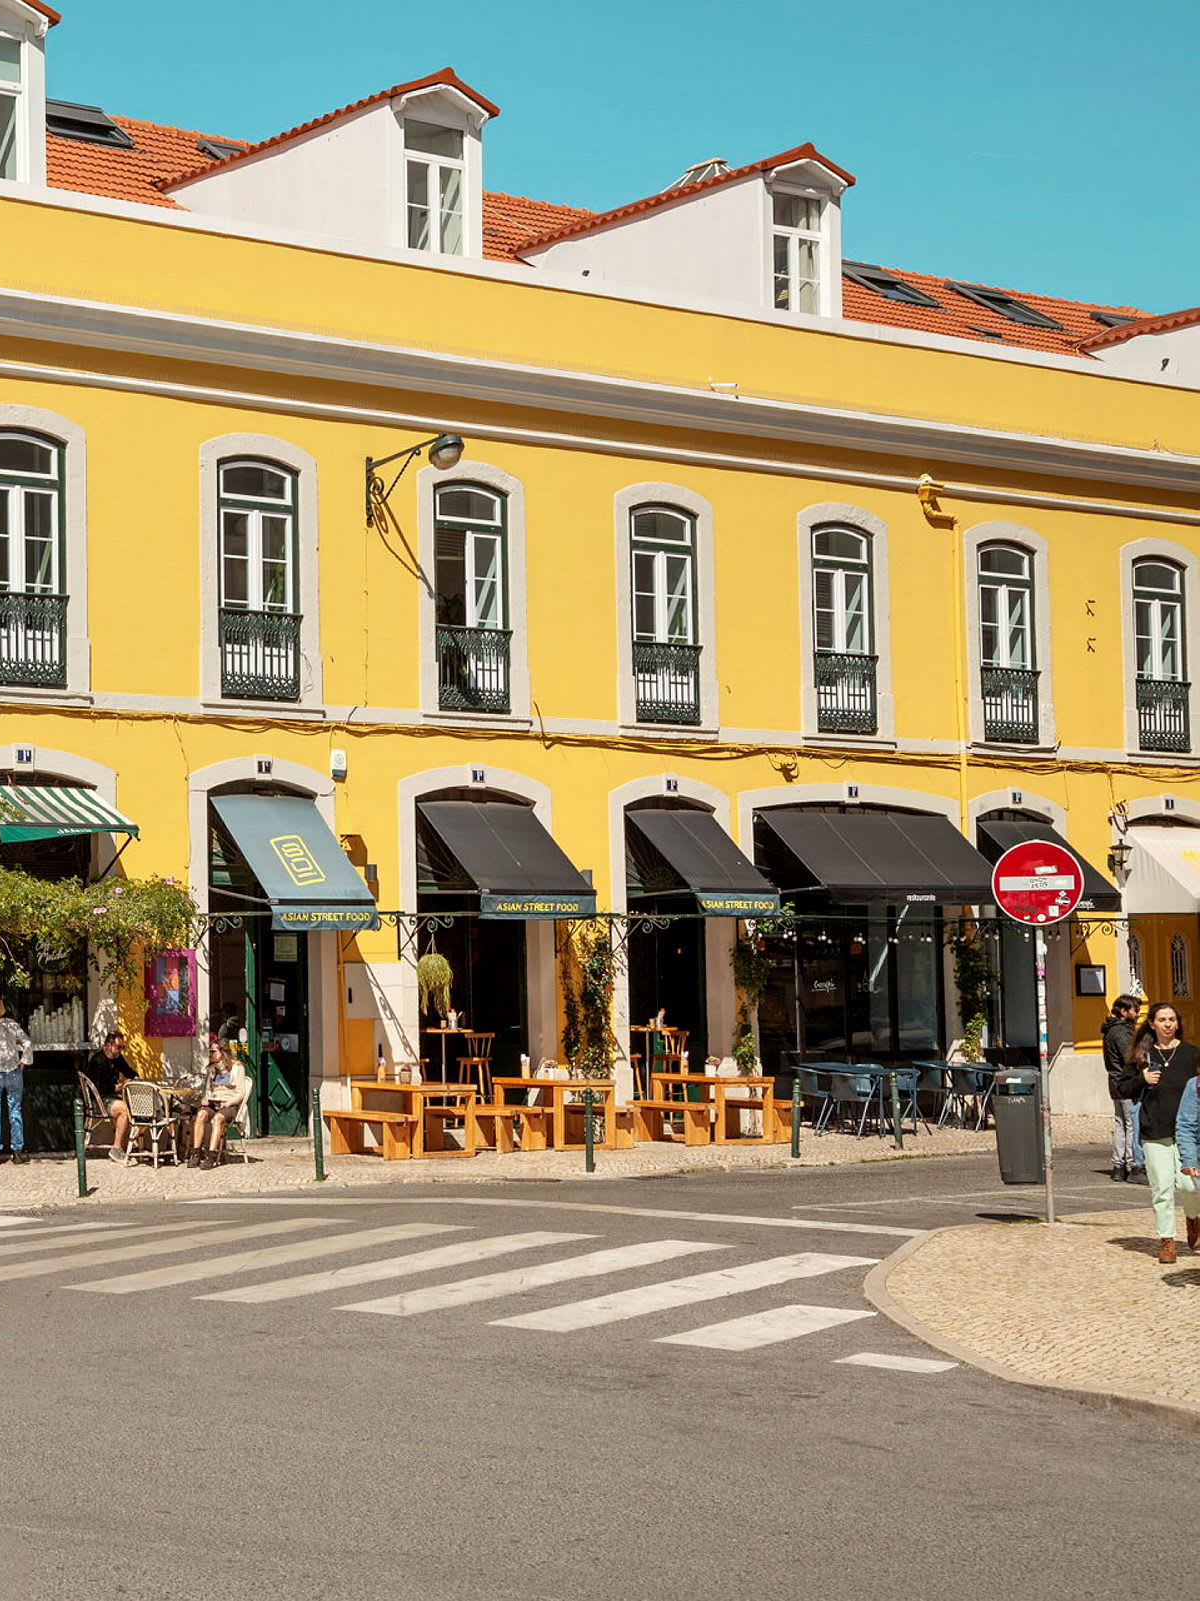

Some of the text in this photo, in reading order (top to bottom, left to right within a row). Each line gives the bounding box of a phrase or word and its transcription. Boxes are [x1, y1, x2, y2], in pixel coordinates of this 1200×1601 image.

[495, 902, 579, 912] ASIAN STREET FOOD
[725, 900, 753, 910] STREET
[754, 901, 774, 910] FOOD
[281, 911, 370, 922] ASIAN STREET FOOD
